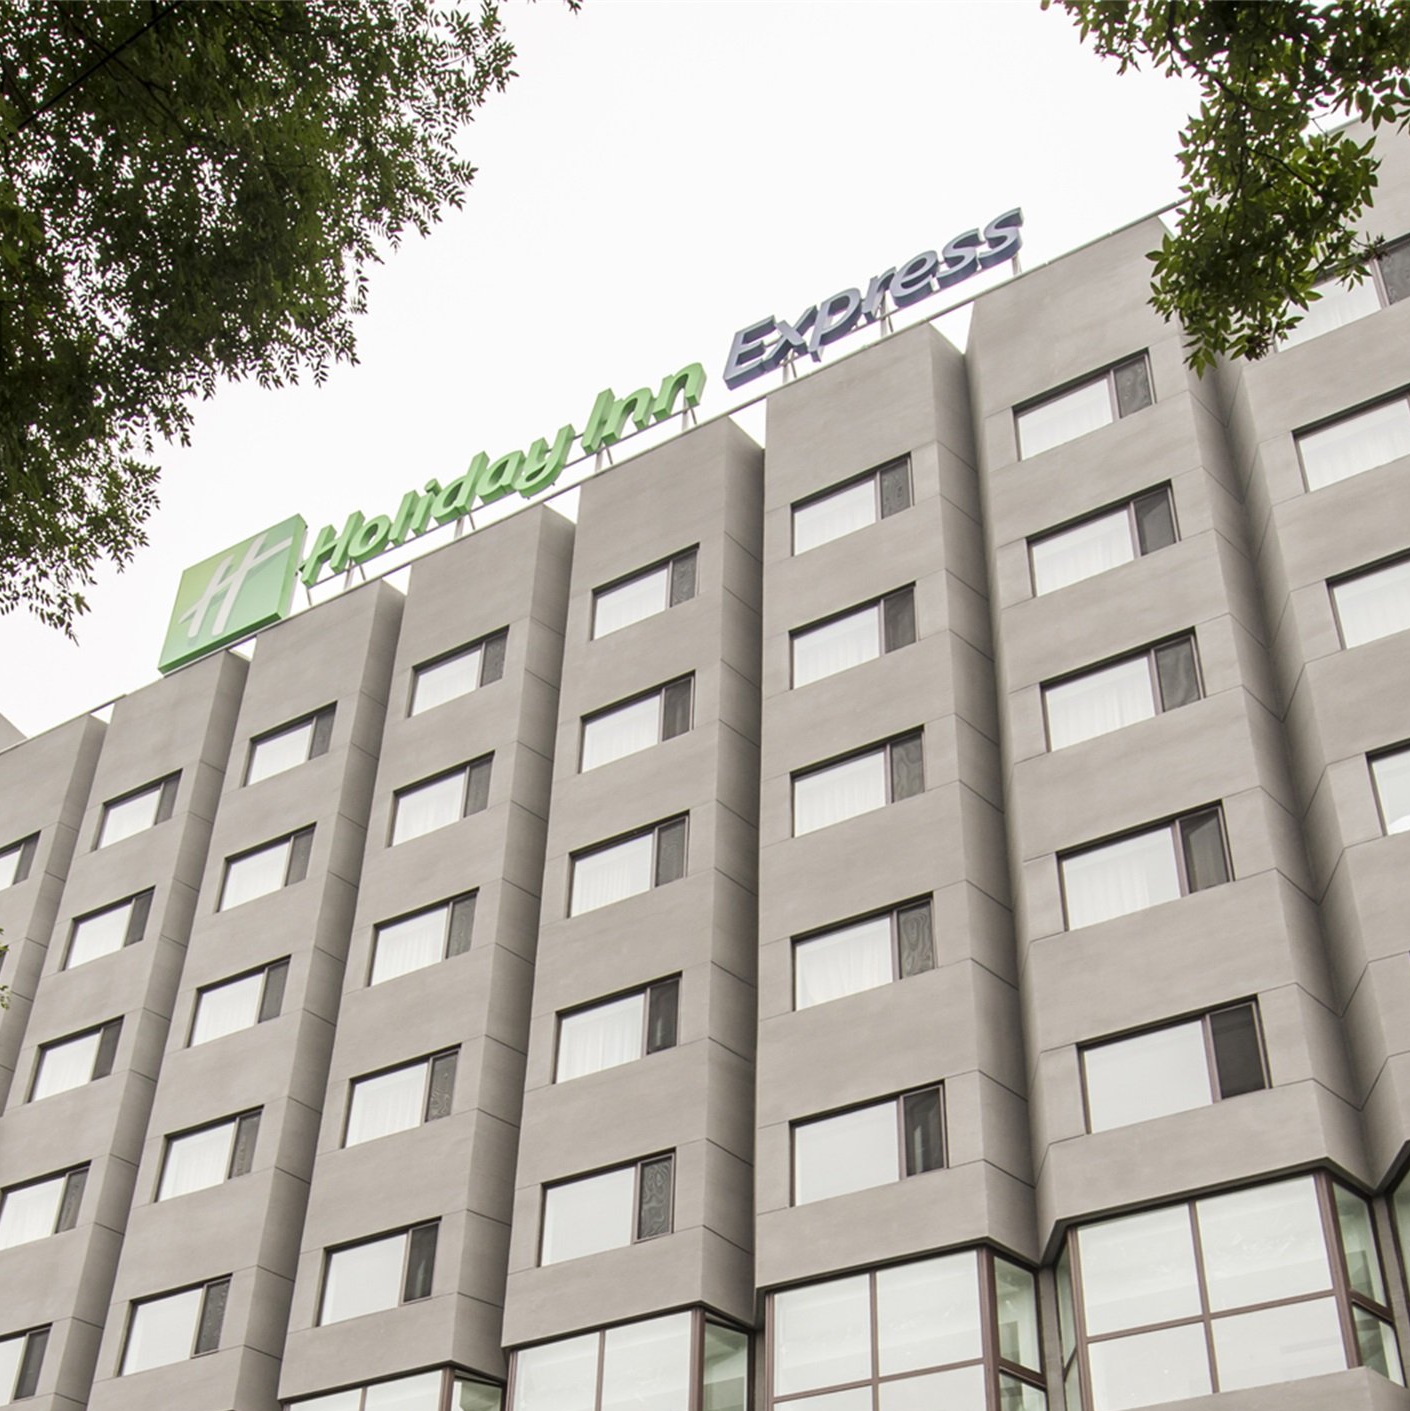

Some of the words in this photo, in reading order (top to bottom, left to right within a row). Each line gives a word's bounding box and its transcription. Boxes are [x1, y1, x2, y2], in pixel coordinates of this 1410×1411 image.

[299, 424, 575, 587] Holiday
[581, 362, 707, 455] Inn
[723, 207, 1024, 391] Express
